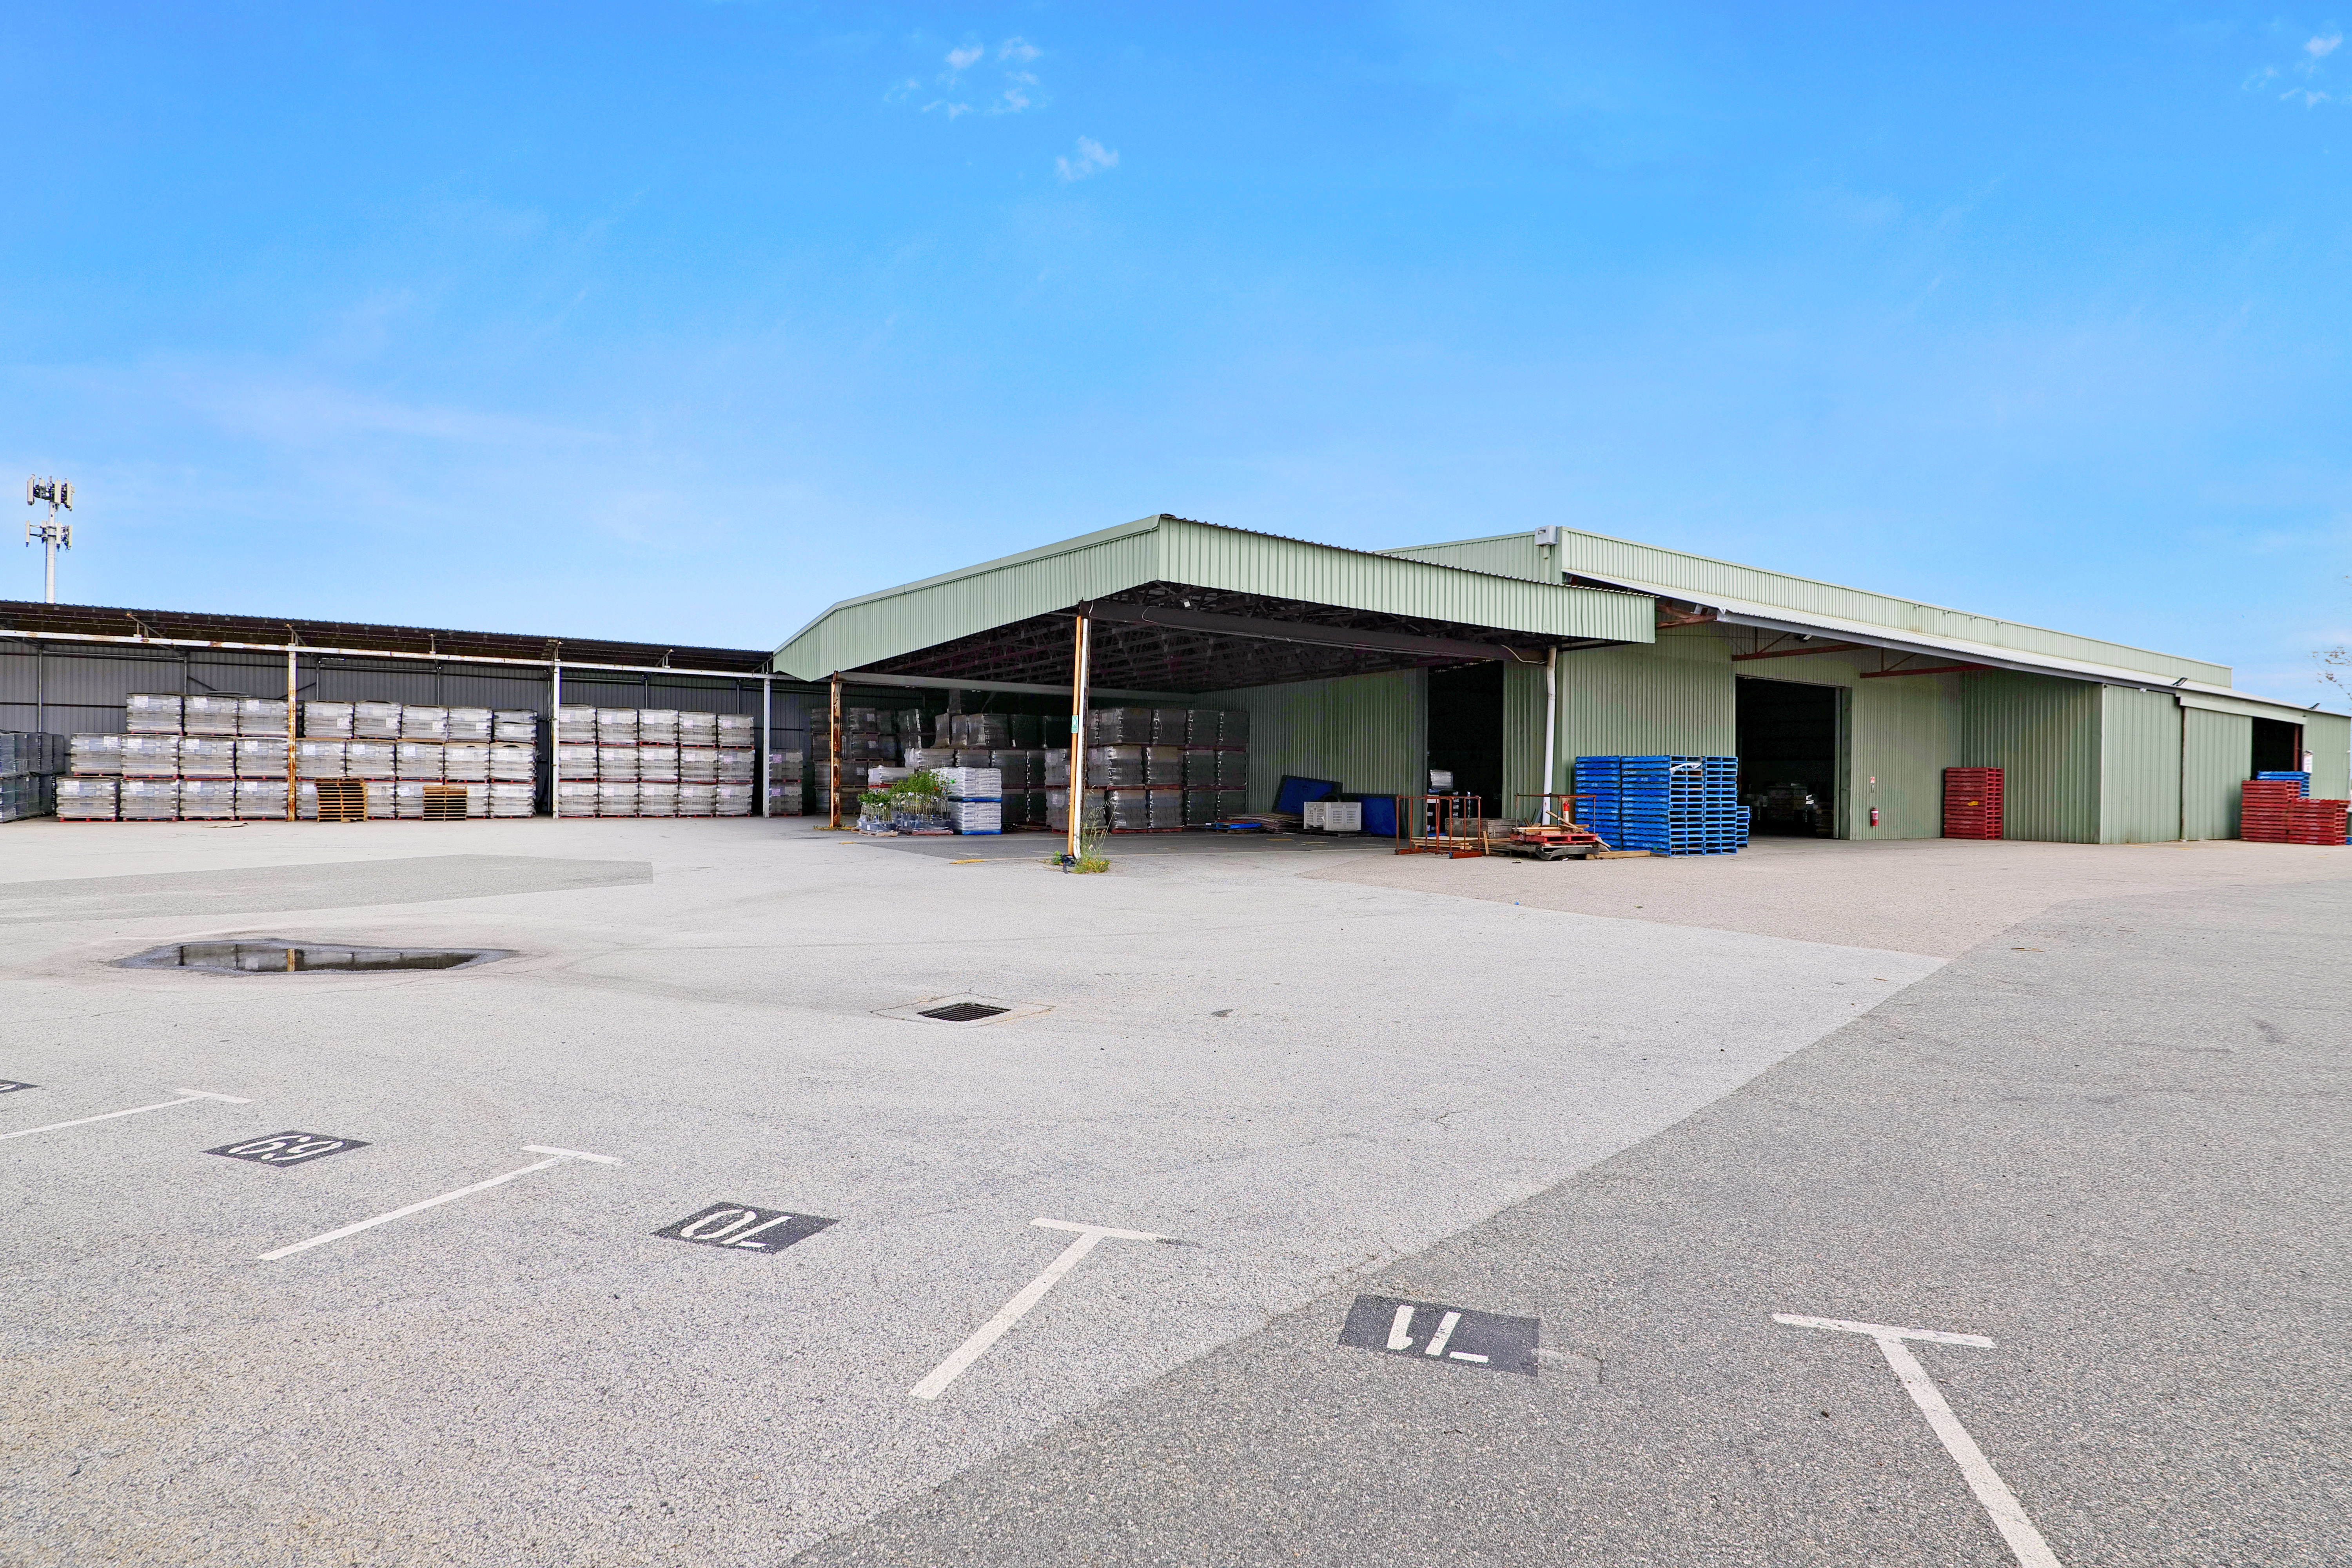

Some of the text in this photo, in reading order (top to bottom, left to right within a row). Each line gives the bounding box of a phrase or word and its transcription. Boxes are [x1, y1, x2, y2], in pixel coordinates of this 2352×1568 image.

[228, 1135, 344, 1161] 69
[680, 1209, 793, 1248] 70
[1387, 1305, 1489, 1363] 71
